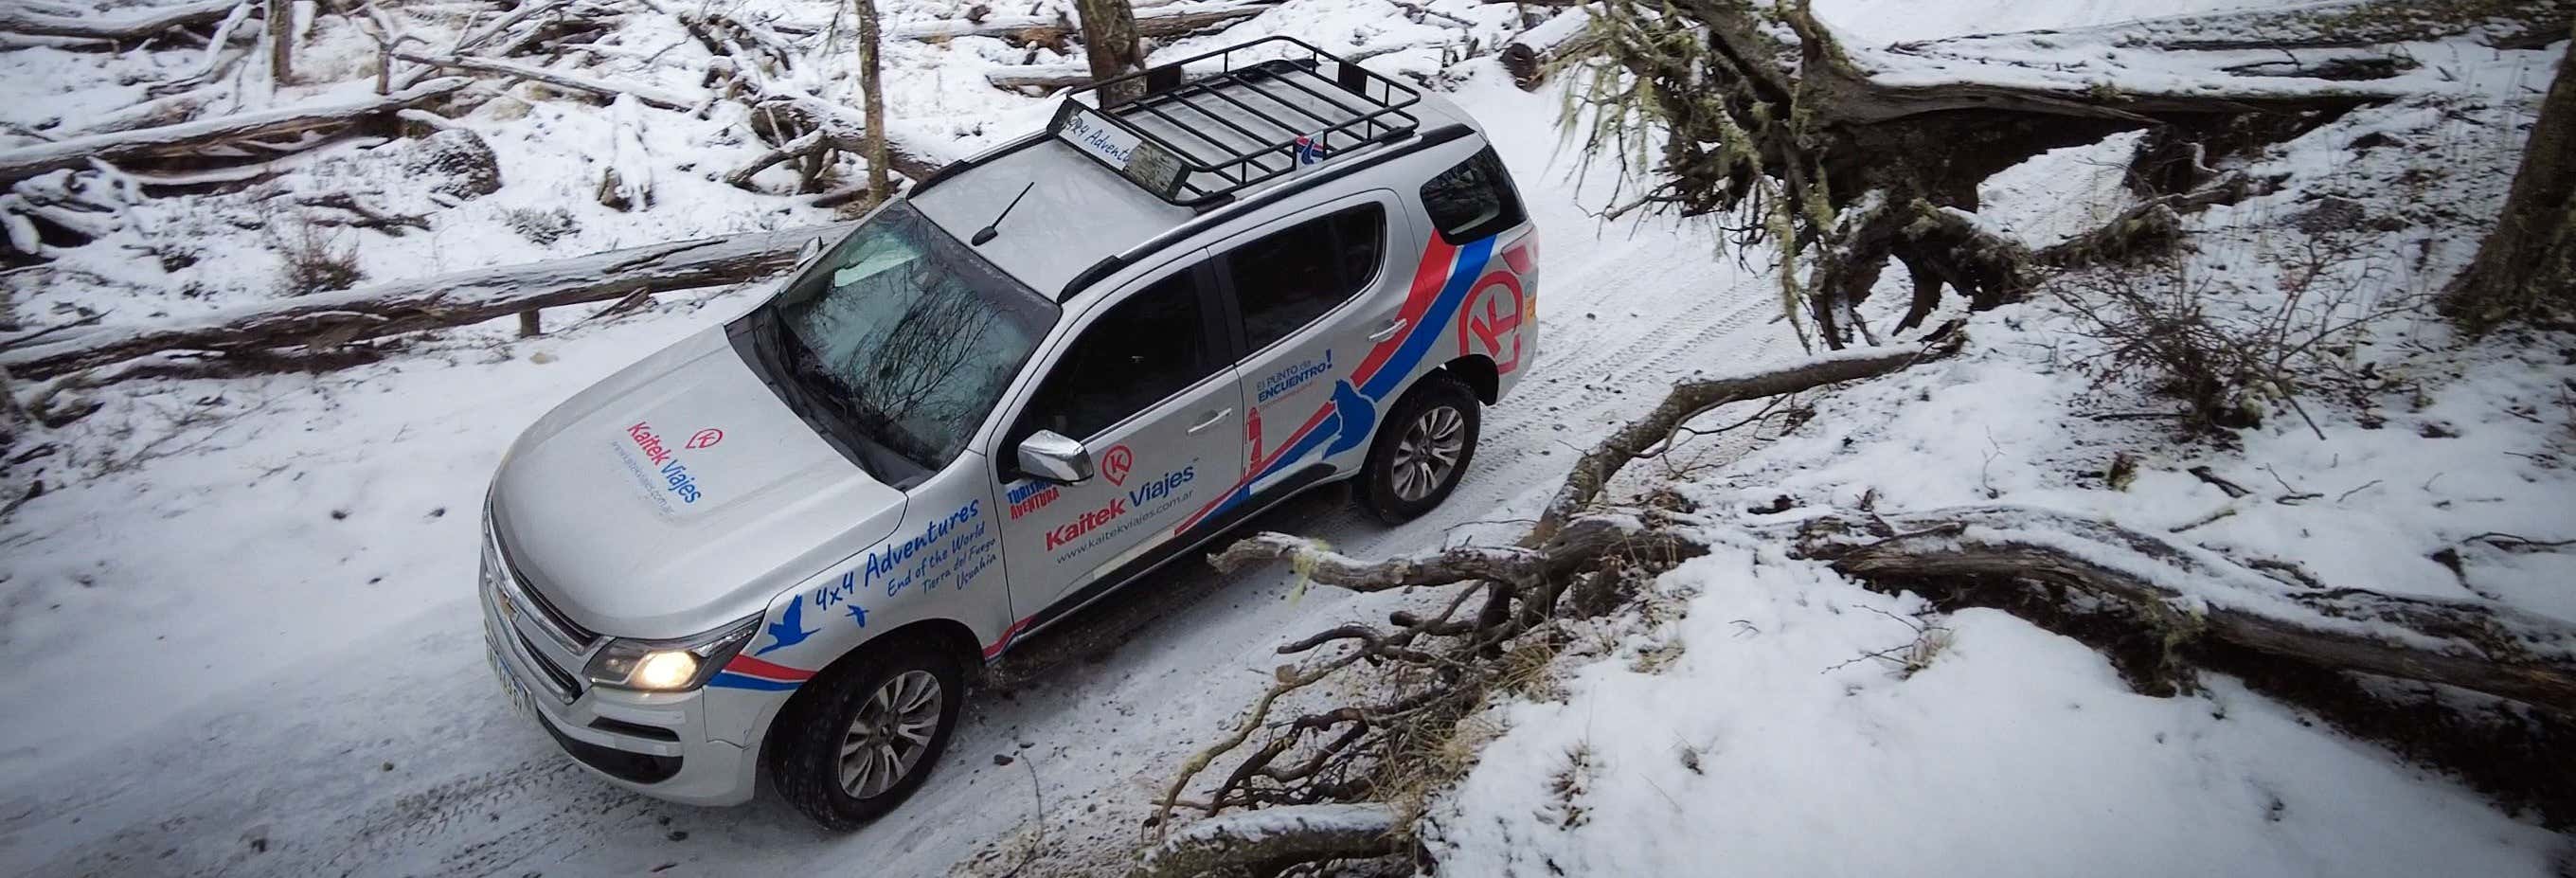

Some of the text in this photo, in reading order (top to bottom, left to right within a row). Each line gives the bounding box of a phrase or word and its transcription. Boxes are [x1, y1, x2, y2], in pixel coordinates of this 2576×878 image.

[1258, 349, 1333, 403] ENCUENTRO!
[1267, 365, 1298, 385] PUNTO
[627, 421, 671, 466] Kaitek
[660, 459, 702, 504] Viajes
[1010, 486, 1060, 520] AVENTURA
[1045, 465, 1195, 551] Kaitek Viajes
[1056, 490, 1193, 564] www.kaitekviajes.com.ar
[815, 499, 980, 610] 4x4 Adventures
[887, 520, 985, 598] End of the World
[922, 538, 996, 595] Tierra del Fuego
